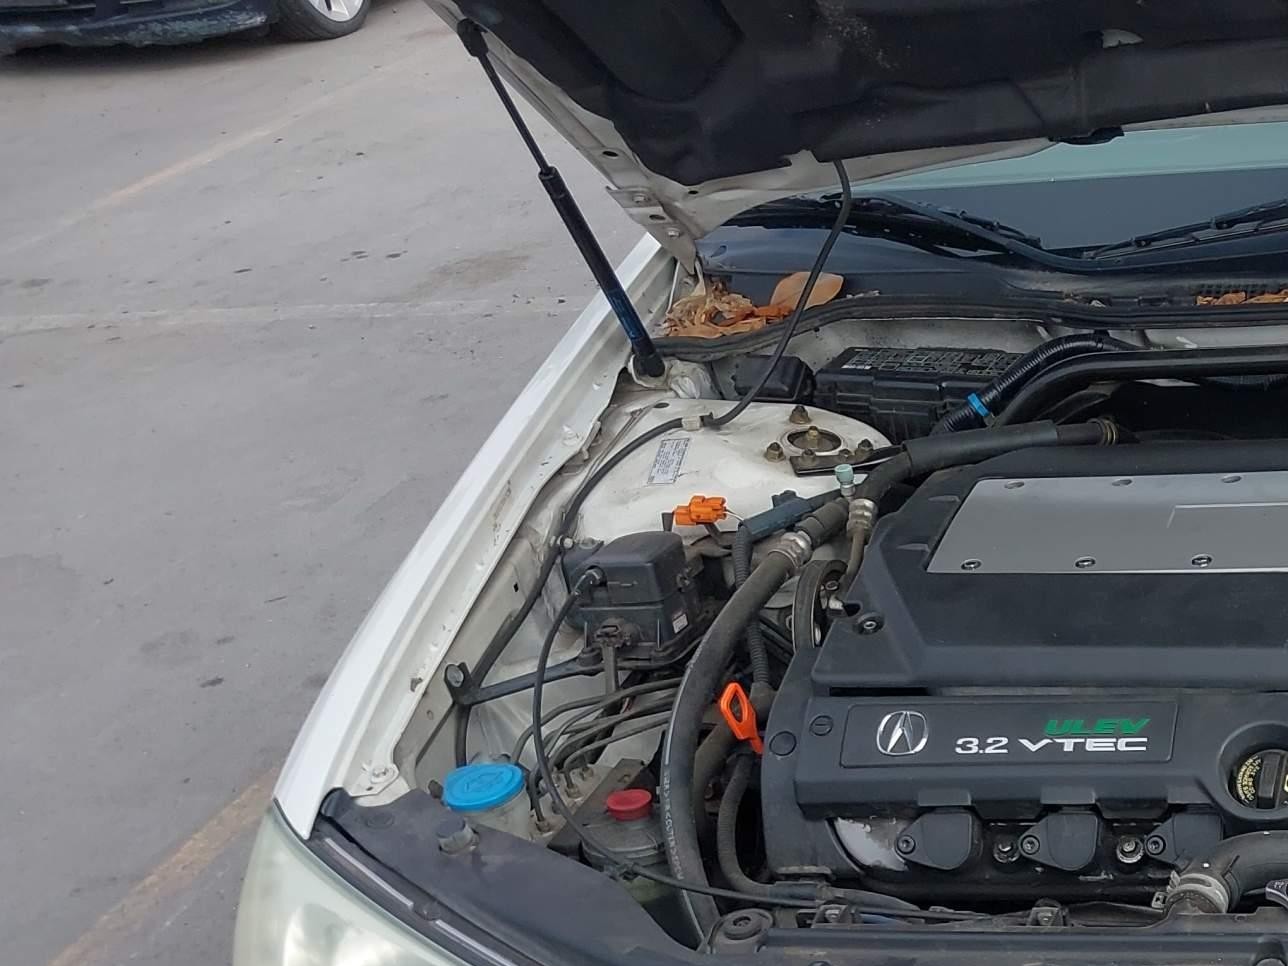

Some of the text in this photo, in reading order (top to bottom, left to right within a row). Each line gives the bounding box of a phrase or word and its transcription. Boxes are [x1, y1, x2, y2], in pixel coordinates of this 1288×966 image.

[1044, 718, 1151, 736] ULEV
[955, 736, 1148, 754] 3.2 VTEC
